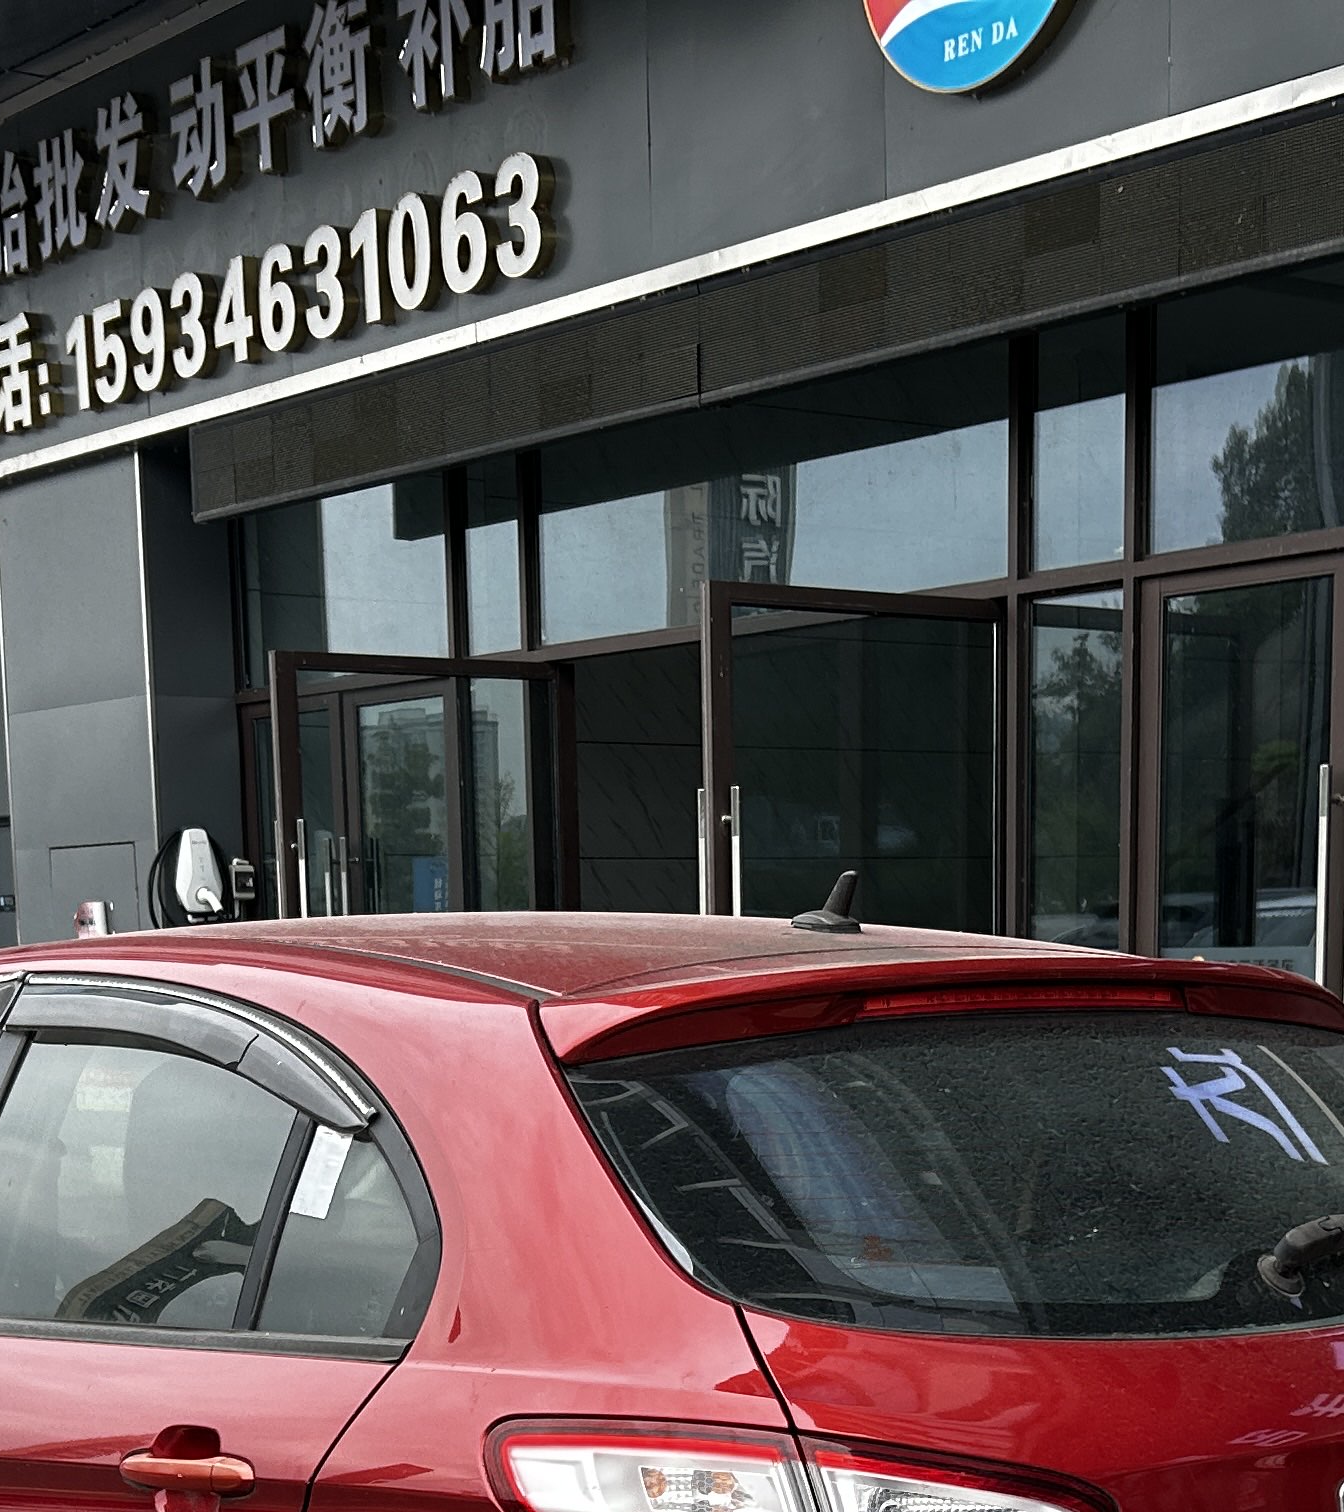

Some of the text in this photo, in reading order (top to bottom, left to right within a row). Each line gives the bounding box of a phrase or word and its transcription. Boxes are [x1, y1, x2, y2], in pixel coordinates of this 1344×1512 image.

[169, 0, 372, 199] 动平衡
[398, 0, 556, 112] 补胎
[943, 16, 1019, 62] REN DA
